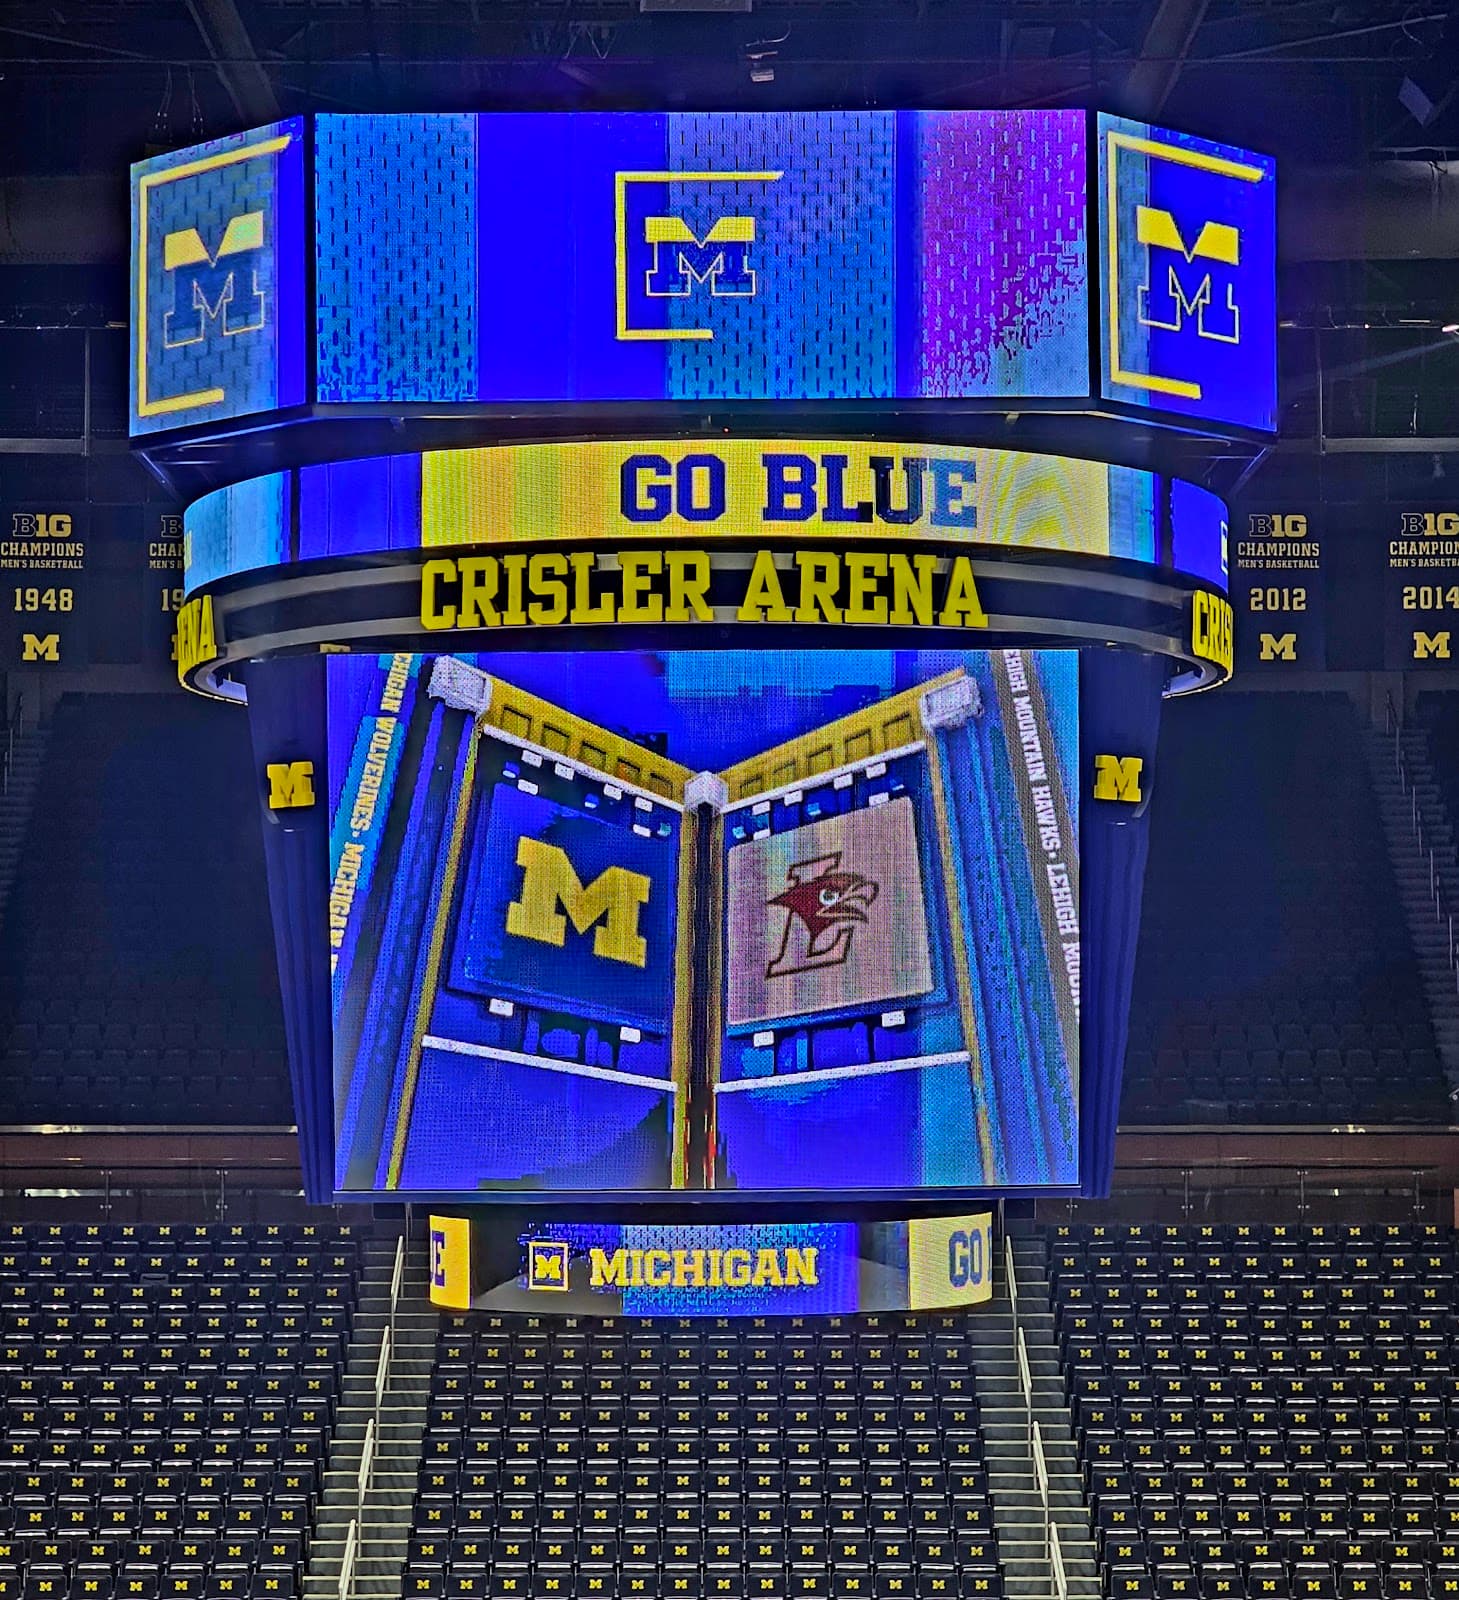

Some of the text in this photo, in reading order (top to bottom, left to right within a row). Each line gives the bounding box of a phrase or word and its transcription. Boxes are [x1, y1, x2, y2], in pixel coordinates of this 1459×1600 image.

[645, 216, 756, 296] M
[164, 211, 264, 348] M
[1136, 205, 1240, 344] M
[620, 453, 977, 528] GO BLUE
[1, 542, 84, 557] CHAMPIONS
[1237, 558, 1320, 569] MEN'S BASKETBALL
[1238, 542, 1320, 557] CHAMPIONS
[1389, 558, 1459, 568] MEN'S BASKETB
[1, 559, 84, 569] MEN'S BASKETBALL
[14, 588, 73, 611] 1948
[420, 549, 989, 630] CRISLER ARENA
[1250, 587, 1307, 611] 2012
[1402, 586, 1459, 610] 2014
[22, 634, 60, 661] M
[1259, 633, 1297, 661] M
[1413, 631, 1451, 659] M
[266, 761, 316, 809] M
[1093, 754, 1143, 803] M
[1013, 696, 1047, 782] MOUNTAIN
[1046, 862, 1080, 936] LEHIGH
[506, 836, 651, 968] M
[534, 1254, 561, 1281] M
[589, 1247, 819, 1287] MICHIGAN
[949, 1228, 983, 1288] GO
